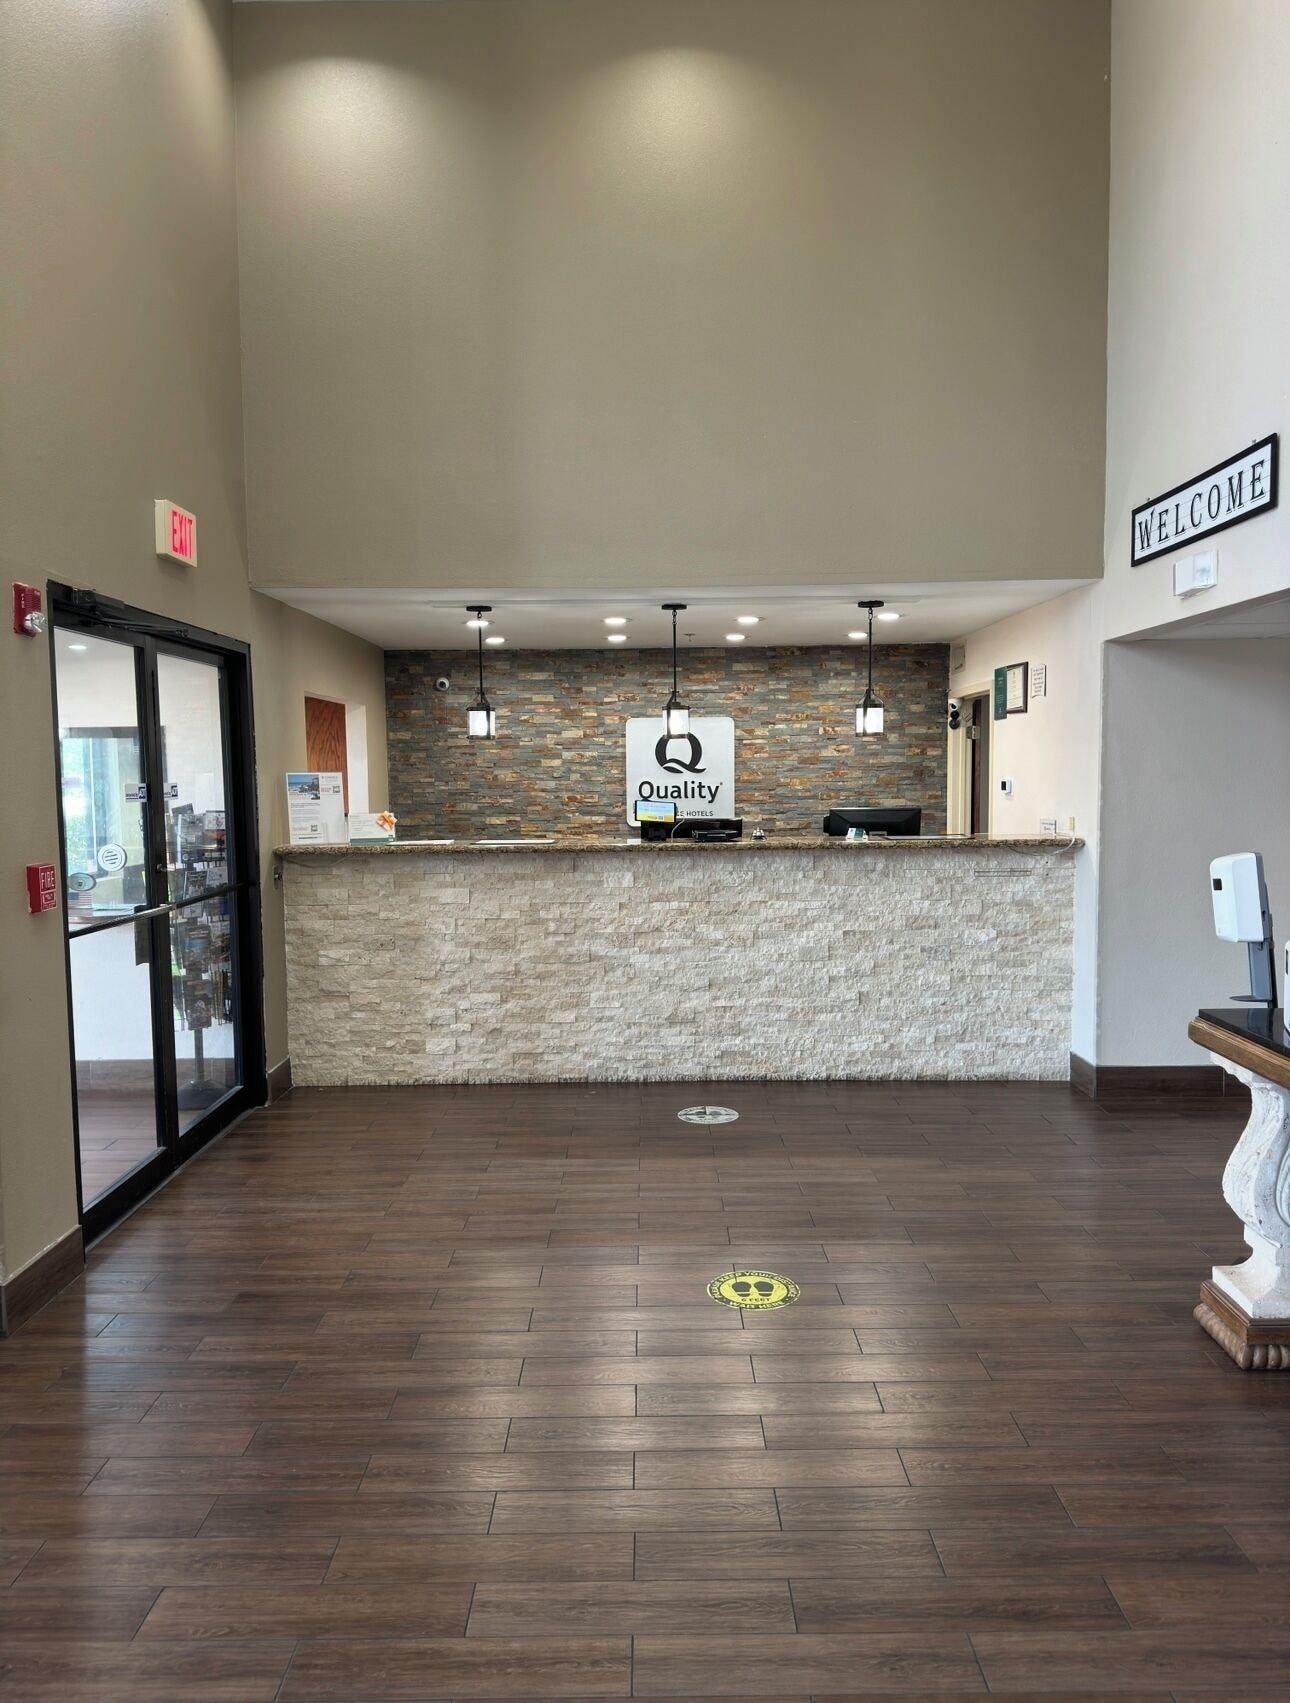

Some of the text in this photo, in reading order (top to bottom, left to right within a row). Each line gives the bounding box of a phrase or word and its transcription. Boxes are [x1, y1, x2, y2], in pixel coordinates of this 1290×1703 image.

[1137, 459, 1265, 550] WELCOME
[172, 510, 193, 559] EXIT
[638, 780, 720, 804] Quality
[40, 871, 55, 889] FIRE
